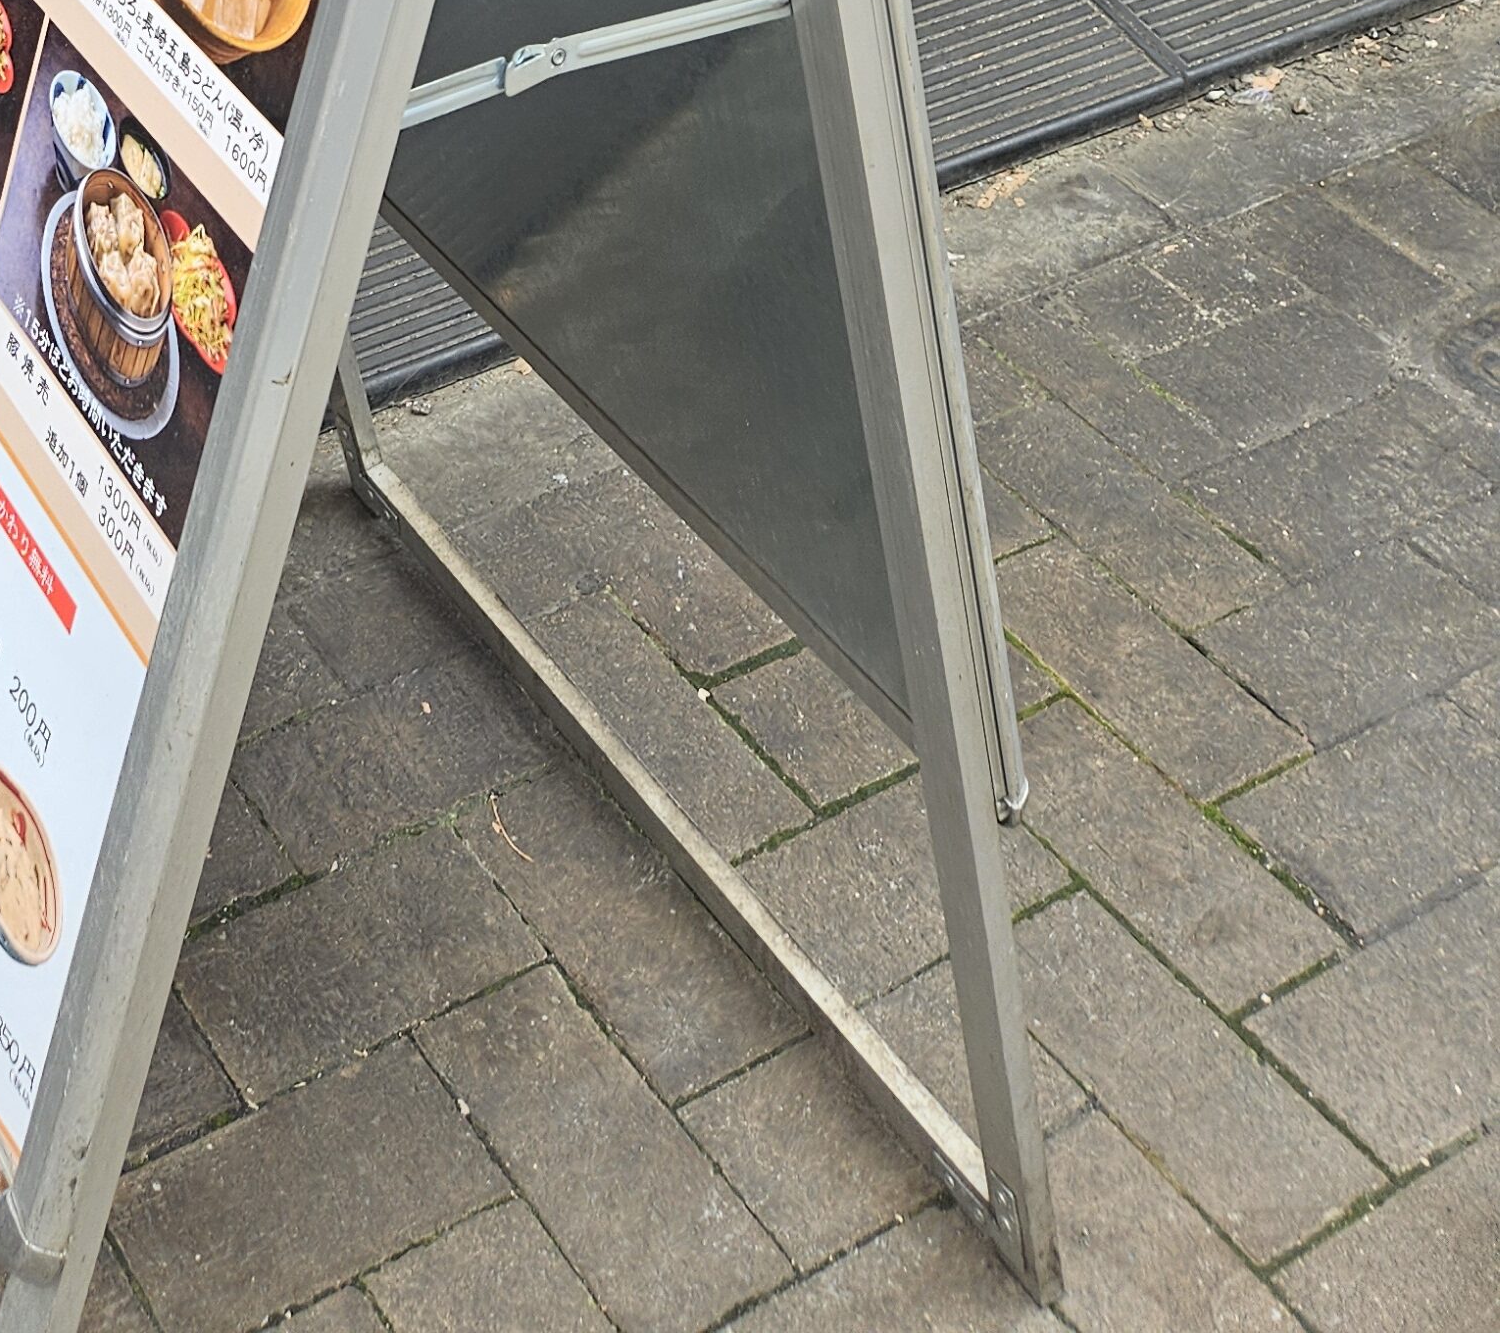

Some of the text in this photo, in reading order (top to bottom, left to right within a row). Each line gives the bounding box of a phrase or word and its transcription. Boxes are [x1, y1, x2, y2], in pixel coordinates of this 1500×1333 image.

[225, 134, 268, 193] 1600円
[98, 464, 142, 541] 1300円
[98, 504, 135, 570] 300円
[8, 675, 52, 753] 200円
